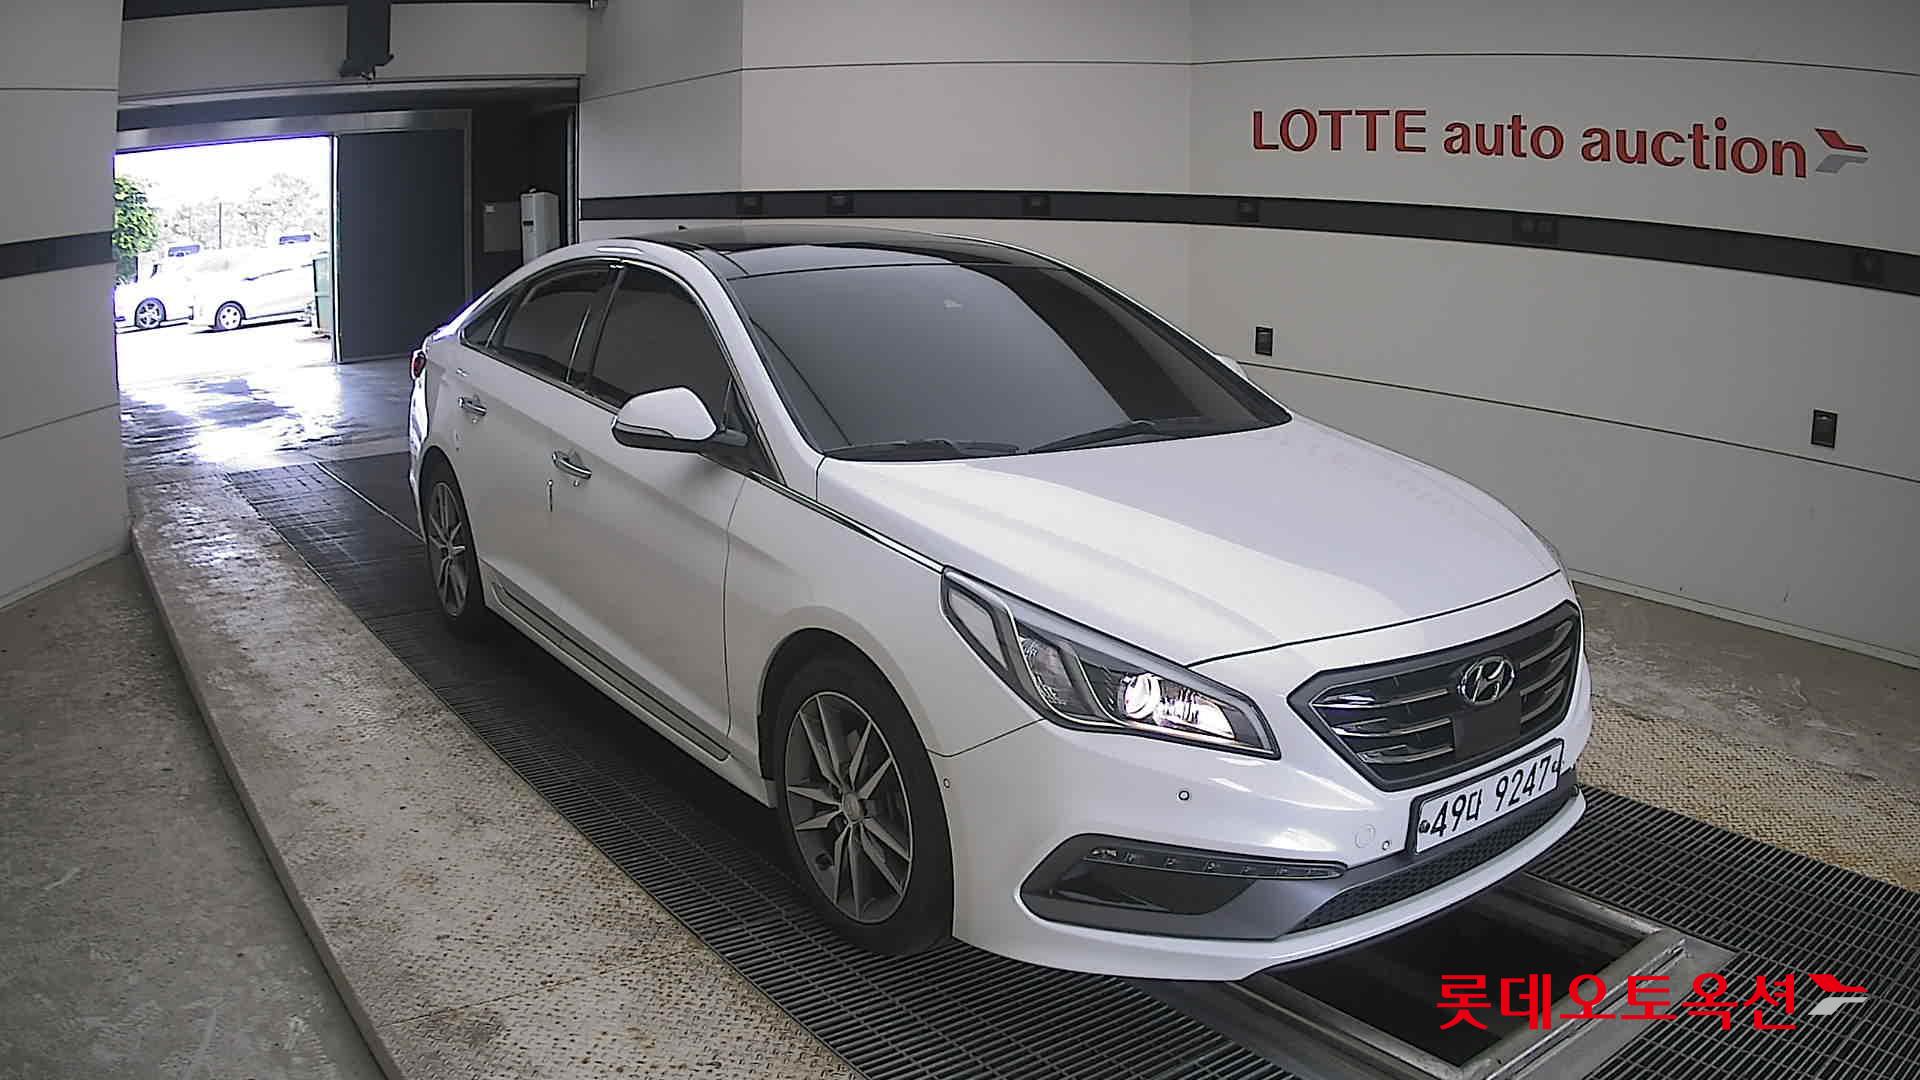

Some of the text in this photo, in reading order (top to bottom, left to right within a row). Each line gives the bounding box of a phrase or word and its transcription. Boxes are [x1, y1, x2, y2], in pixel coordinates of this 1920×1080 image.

[1253, 108, 1807, 178] LOTTE auto auction
[1495, 755, 1552, 812] 9247
